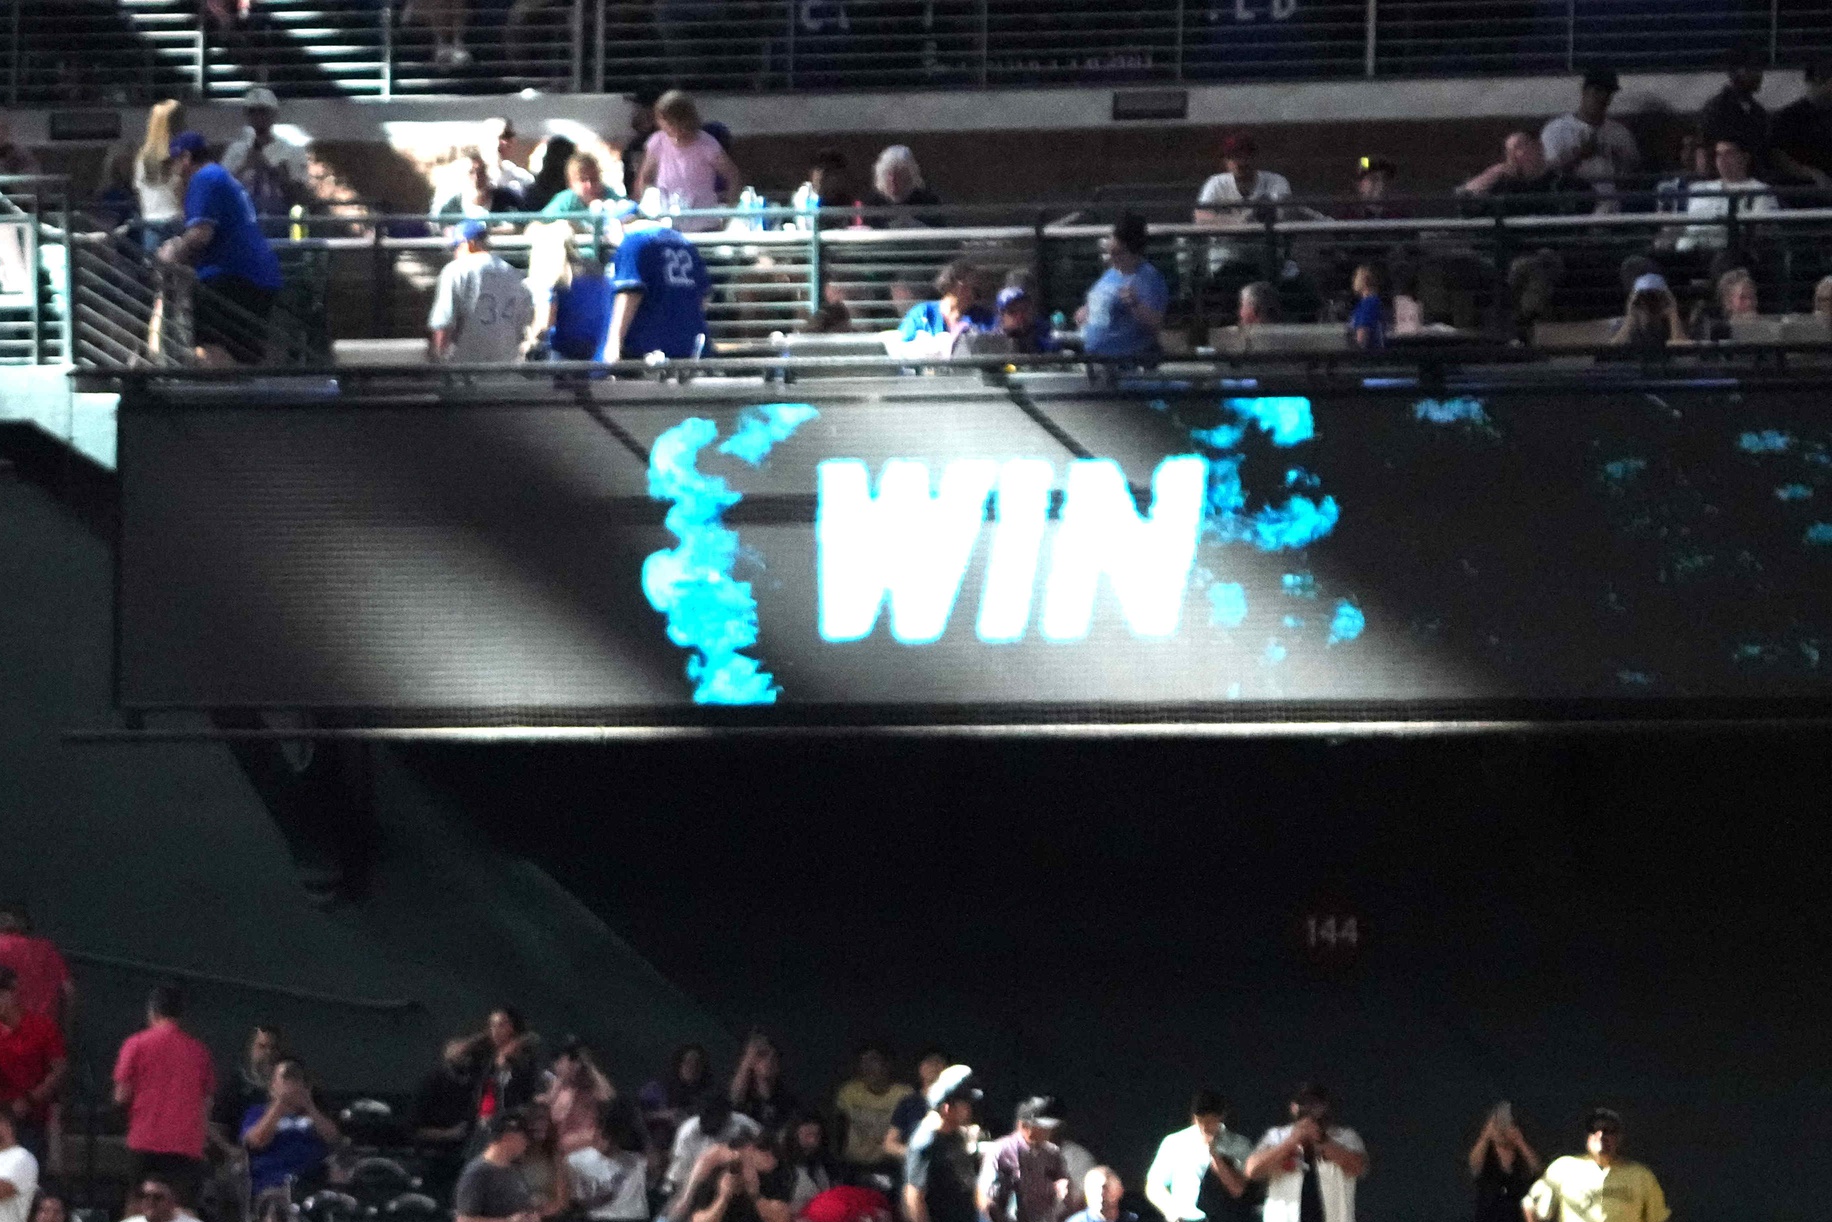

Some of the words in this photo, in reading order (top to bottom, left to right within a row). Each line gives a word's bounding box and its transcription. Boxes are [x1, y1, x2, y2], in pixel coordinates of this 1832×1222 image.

[664, 247, 697, 288] 22
[817, 453, 1209, 645] WIN
[1307, 916, 1358, 946] 144
